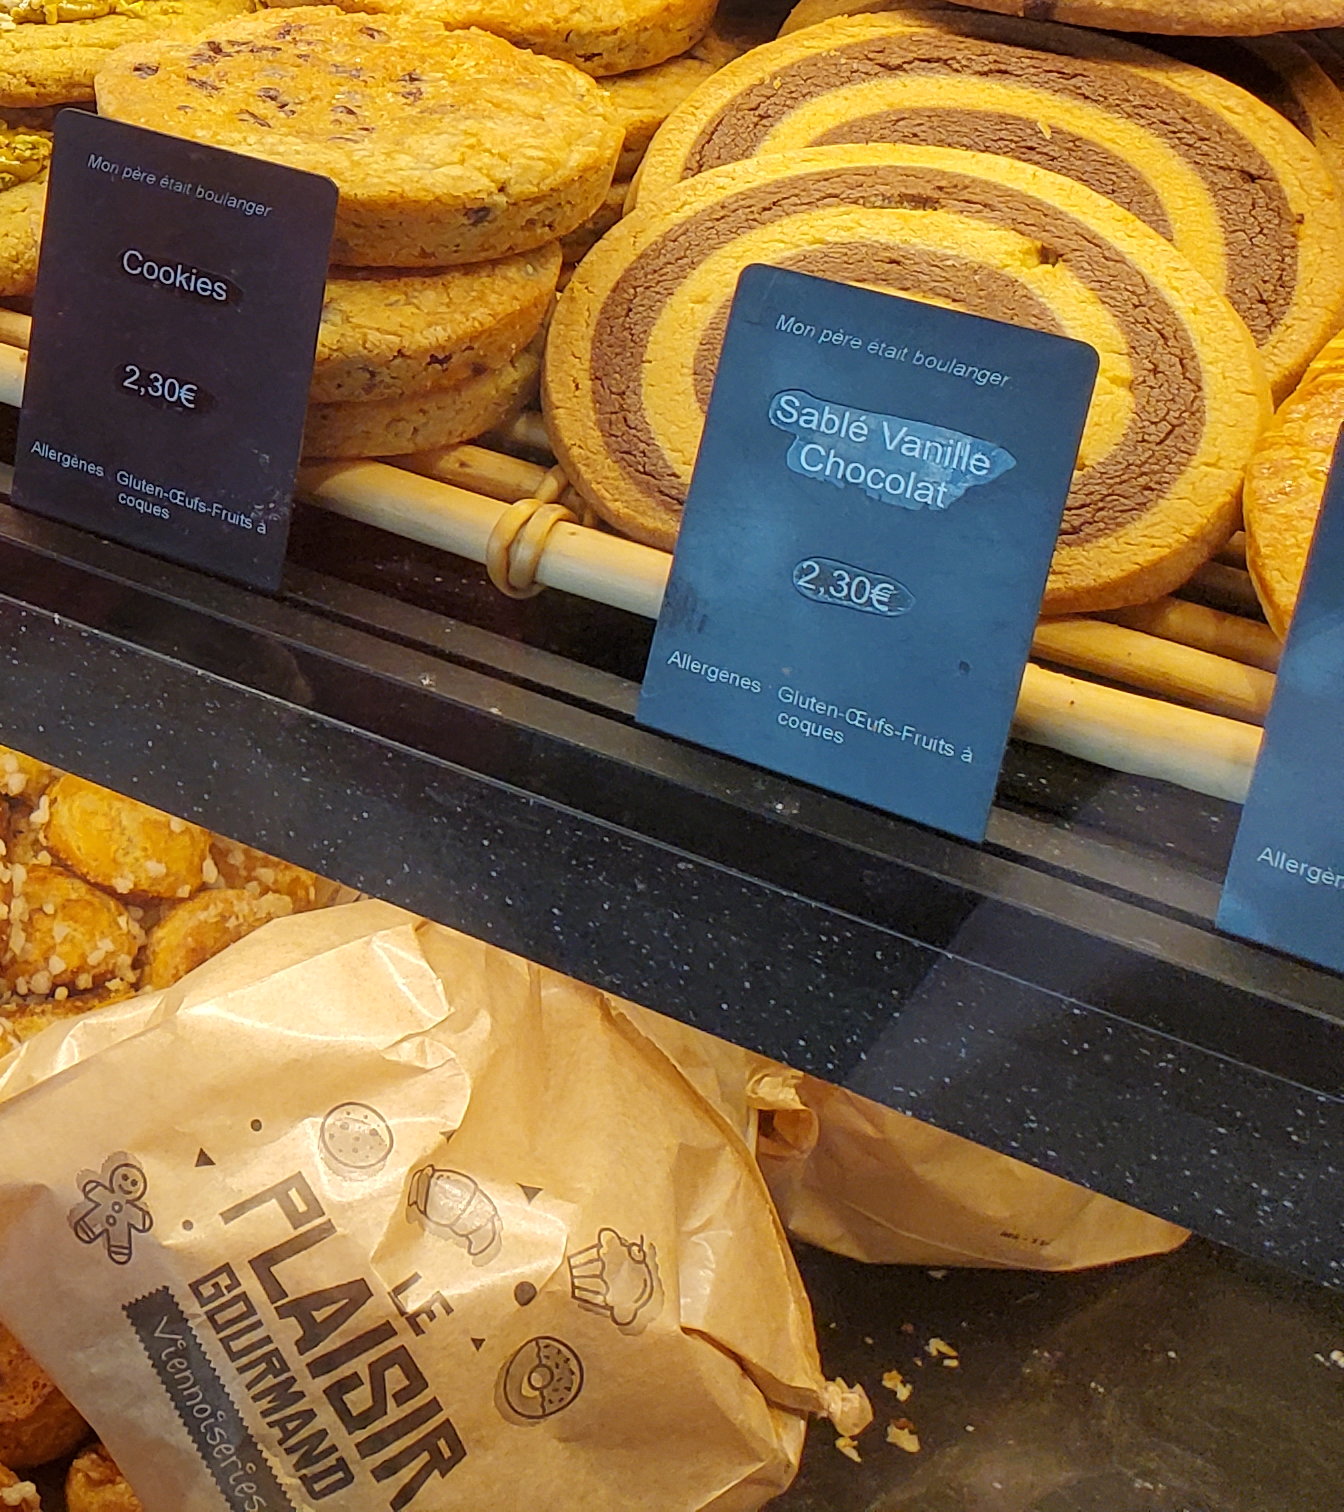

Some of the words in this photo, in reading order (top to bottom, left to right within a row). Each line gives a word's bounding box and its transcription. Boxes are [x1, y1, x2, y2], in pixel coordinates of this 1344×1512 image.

[87, 154, 119, 174] Mon
[121, 166, 156, 185] père
[159, 174, 192, 195] était
[195, 184, 273, 217] boulanger
[123, 250, 227, 301] Cookies
[775, 314, 816, 338] Mon
[818, 328, 862, 349] père
[867, 338, 909, 361] était
[913, 350, 1011, 387] boulanger
[122, 365, 198, 408] 2,30€
[775, 395, 868, 442] Sablé
[882, 421, 991, 475] Vanille
[118, 492, 170, 520] coques
[800, 444, 948, 508] Chocolat
[797, 561, 894, 612] 2,30€
[777, 712, 844, 744] coques
[388, 1271, 454, 1337] LE
[218, 1170, 468, 1512] PLAISIR
[154, 1315, 267, 1512] Viennoiseries
[188, 1262, 356, 1502] GOURMAND
